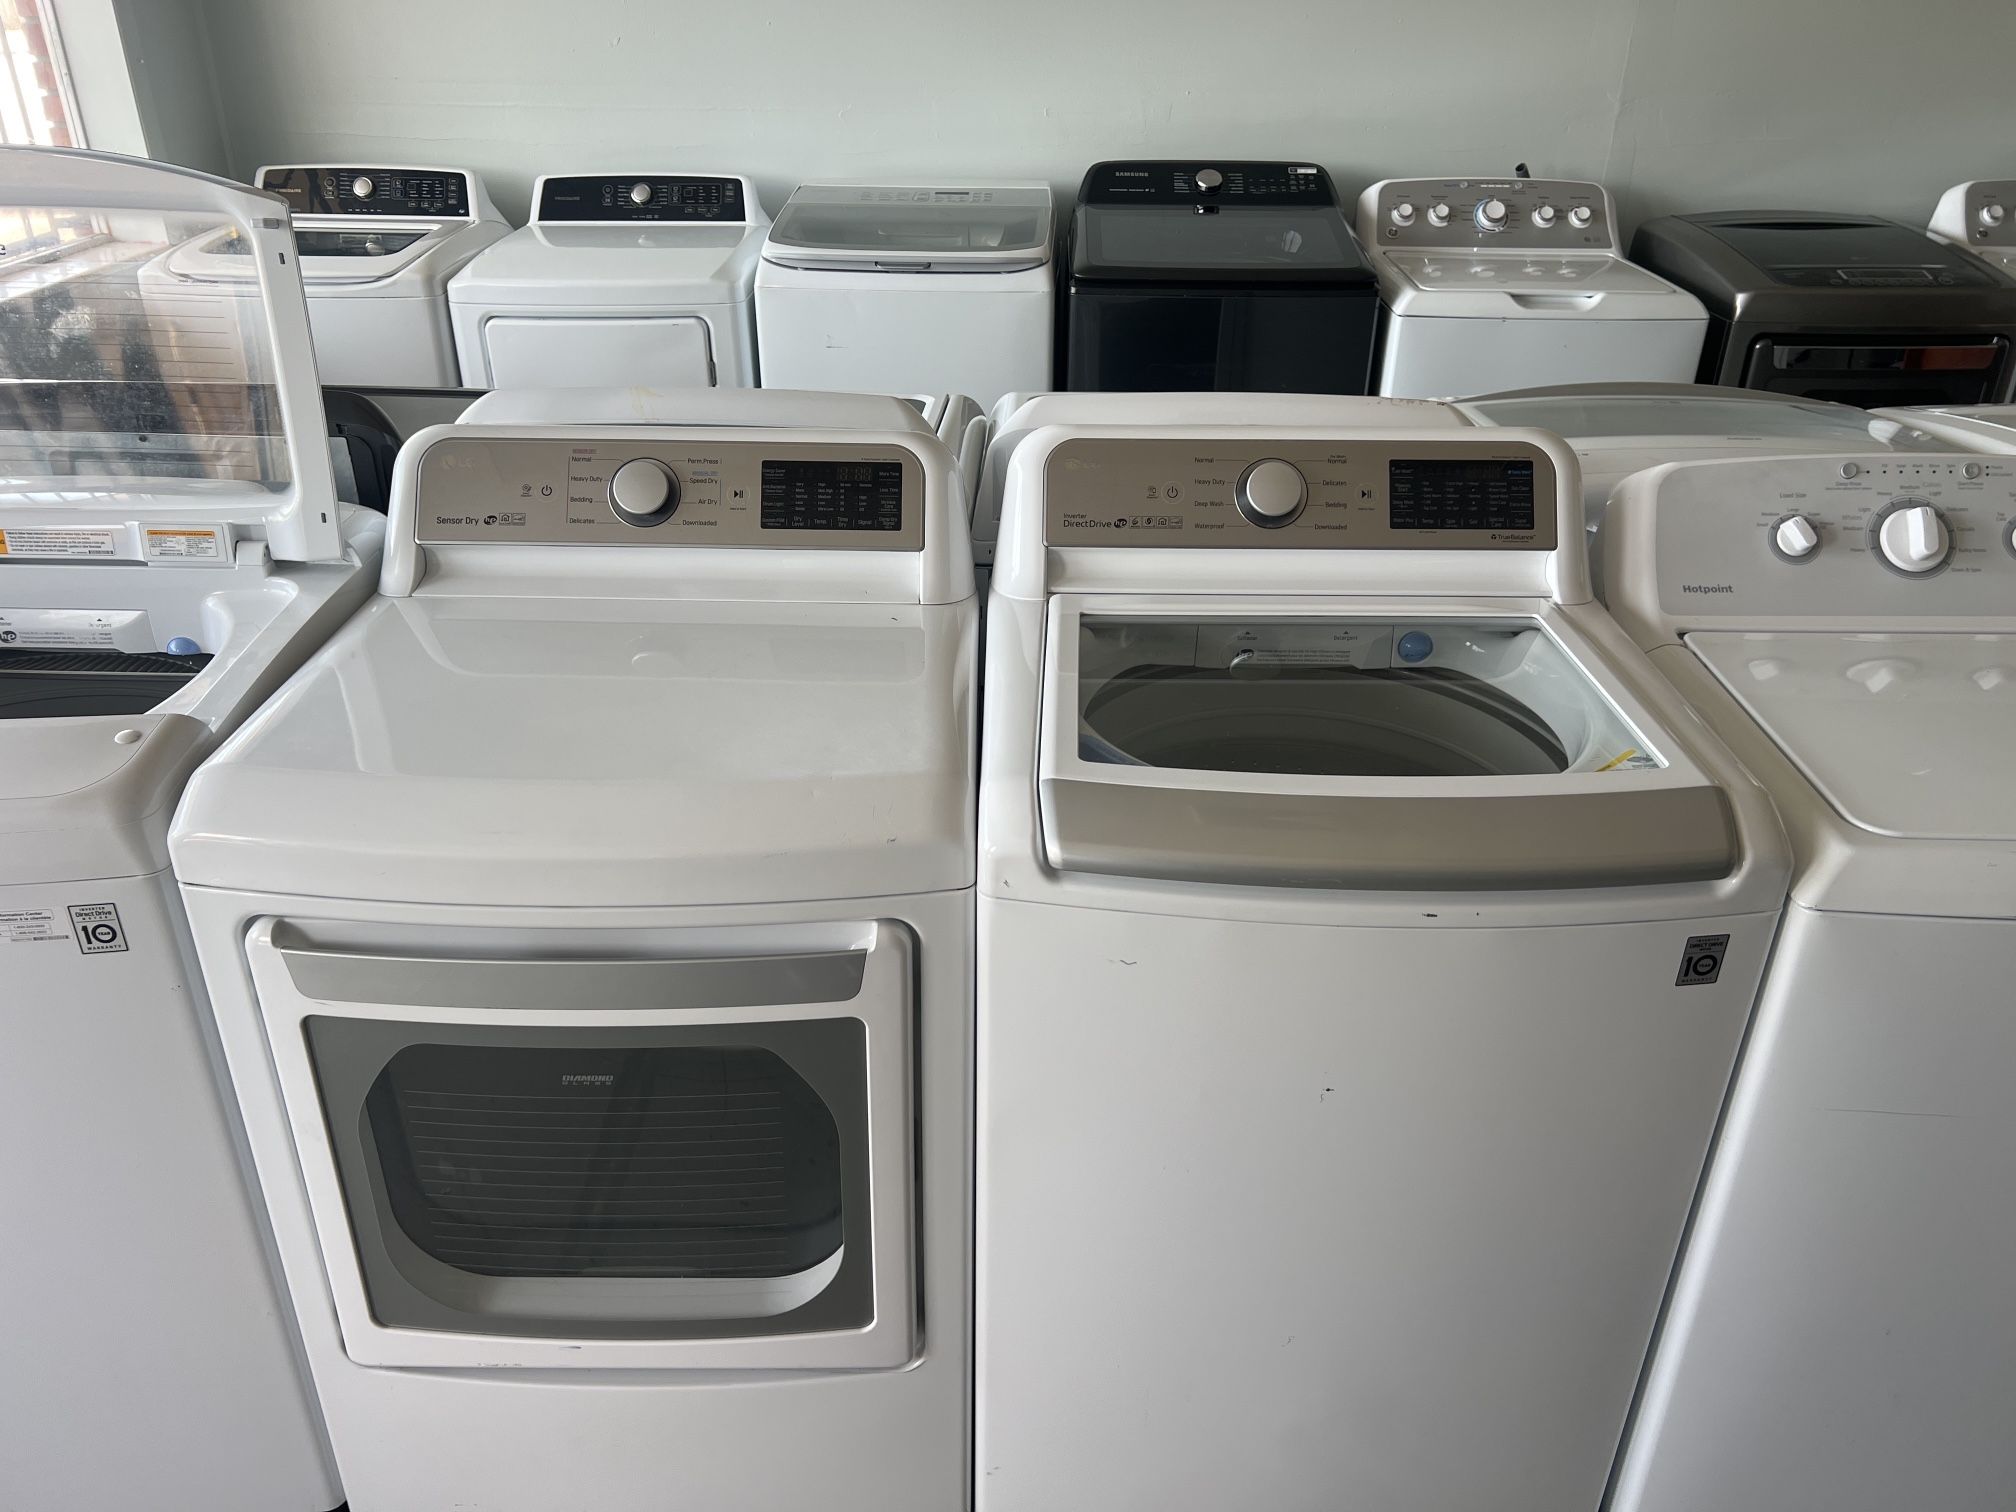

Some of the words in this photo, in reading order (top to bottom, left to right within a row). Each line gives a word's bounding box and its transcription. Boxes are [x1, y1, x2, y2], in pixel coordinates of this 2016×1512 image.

[1212, 478, 1226, 486] Duty
[1194, 500, 1209, 508] Deep
[436, 516, 464, 525] Sensor
[465, 516, 480, 526] Dry
[569, 517, 596, 525] Delicates
[1682, 583, 1734, 595] Hotpoint
[81, 923, 118, 945] 10
[1682, 954, 1718, 978] 10
[561, 1074, 614, 1082] DIAMOND
